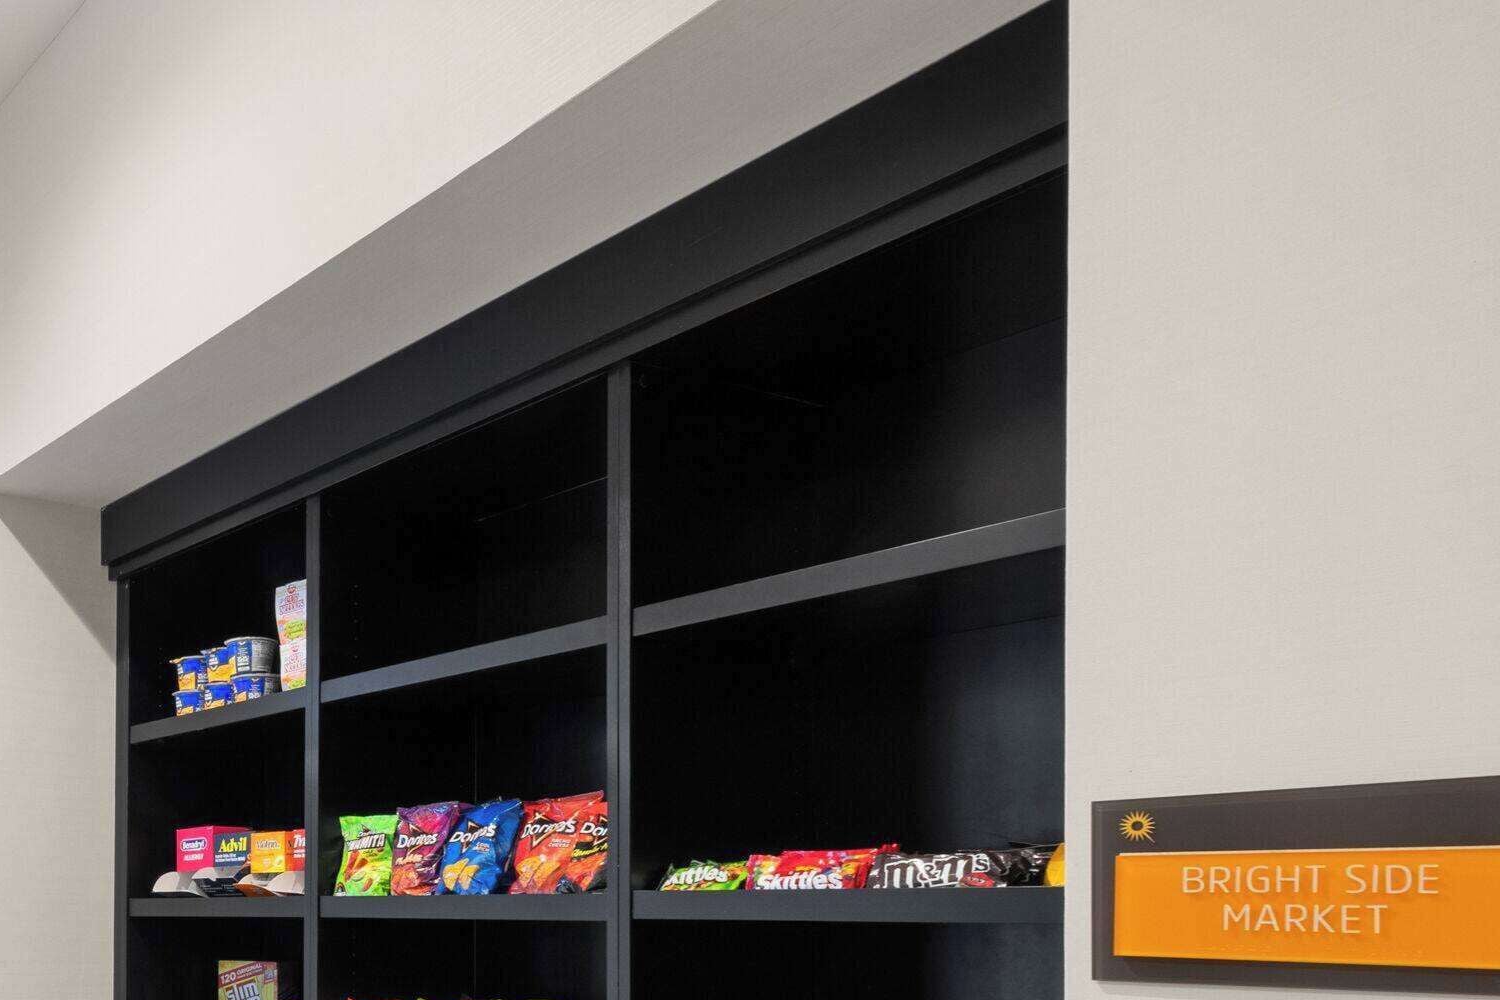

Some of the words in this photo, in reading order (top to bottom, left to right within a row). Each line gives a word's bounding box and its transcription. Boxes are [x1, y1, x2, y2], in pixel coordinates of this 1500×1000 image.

[449, 824, 498, 843] Doritos
[521, 820, 576, 839] Doritos
[219, 837, 248, 853] Advil
[397, 834, 438, 848] Doritos
[755, 870, 843, 889] Skittles
[1182, 864, 1326, 894] BRIGHT
[1345, 864, 1440, 894] SIDE
[1221, 904, 1388, 934] MARKET
[220, 971, 237, 985] 120
